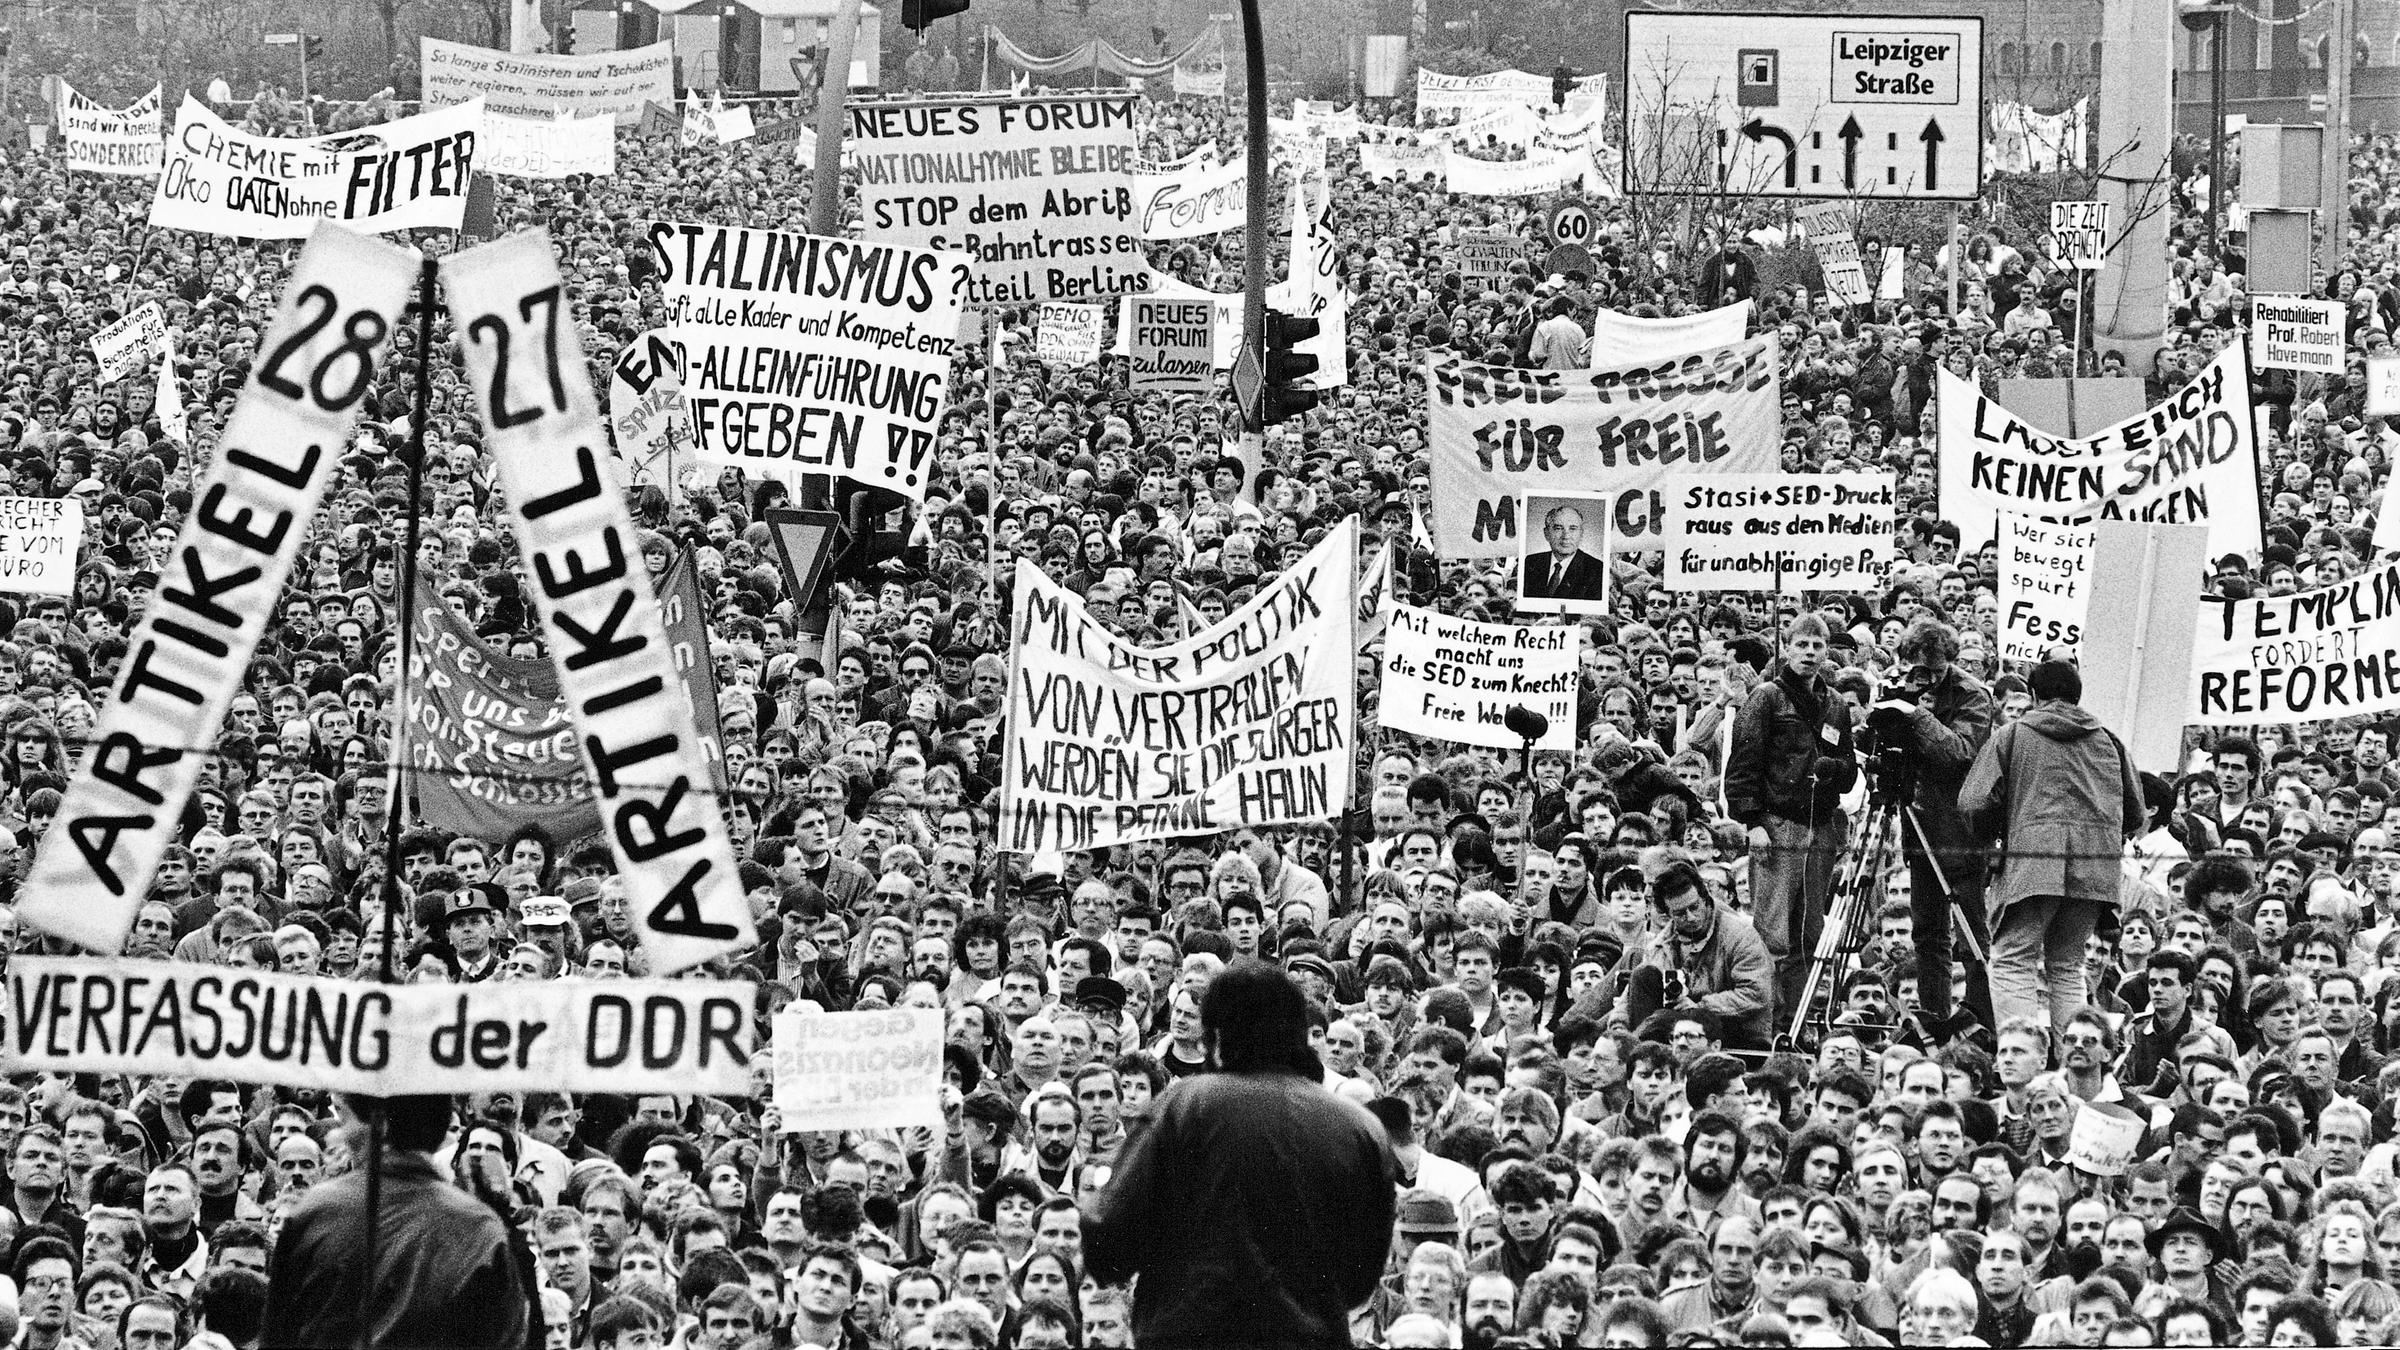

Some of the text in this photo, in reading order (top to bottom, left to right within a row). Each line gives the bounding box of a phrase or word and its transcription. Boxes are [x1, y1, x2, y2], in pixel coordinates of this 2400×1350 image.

[494, 60, 571, 78] Stalinisten
[577, 67, 601, 78] und
[1840, 37, 1950, 68] Leipziger
[430, 74, 466, 86] weiter
[537, 85, 583, 98] müssen
[590, 85, 608, 96] wir
[1855, 71, 1934, 95] Straße
[854, 101, 1134, 139] NEUES FORUM
[165, 151, 210, 203] Öko
[290, 199, 338, 219] ohne
[182, 122, 296, 179] CHEMIE
[304, 155, 340, 178] mit
[343, 130, 475, 219] FILTER
[857, 148, 1042, 185] NATIONALHYMNE
[875, 186, 1131, 229] STOP dem Abriß
[2056, 203, 2109, 229] DIE ZEIT
[1557, 214, 1587, 239] 60
[648, 222, 938, 313] STALINISMUS
[1047, 265, 1150, 298] Berlins
[695, 298, 736, 326] alle
[741, 301, 793, 330] Kader
[799, 310, 833, 337] und
[837, 310, 956, 357] Kompetenz
[1041, 306, 1092, 323] DEMO
[1139, 303, 1208, 325] NEUES
[2256, 302, 2329, 326] Rehabilitiert
[258, 282, 387, 413] 28
[1138, 327, 1207, 348] FORUM
[2268, 323, 2340, 346] Prof. Robert
[468, 283, 570, 432] 27
[1133, 350, 1212, 375] zulassen
[1434, 343, 1771, 408] FREIE PRESSE
[1472, 410, 1730, 473] FÜR FREIE
[1972, 410, 2239, 503] KEINEN SAND
[1685, 512, 1893, 536] raus aus den Medien
[21, 536, 63, 555] VOM
[1680, 548, 1707, 574] für
[2014, 546, 2085, 577] bewegt
[2011, 573, 2076, 599] spürt
[1021, 587, 1091, 659] MIT
[1109, 642, 1180, 683] DER
[1193, 566, 1321, 675] POLITIK
[1391, 608, 1566, 650] Mit welchem Recht
[2007, 600, 2084, 645] Fess
[1435, 648, 1524, 669] macht uns
[2005, 641, 2046, 661] nich
[70, 443, 322, 898] ARTIKEL
[1389, 653, 1578, 694] die SED zum Knecht?
[462, 690, 529, 727] uns
[519, 445, 740, 942] ARTIKEL
[1022, 667, 1103, 738] VON
[1422, 692, 1466, 722] Freie
[1020, 737, 1139, 801] WERDEN
[1152, 752, 1196, 798] SIE
[1013, 798, 1047, 851] IN
[1056, 804, 1102, 851] DIE
[1238, 762, 1328, 823] HAUN
[13, 972, 752, 1072] VERFASSUNG der DDR
